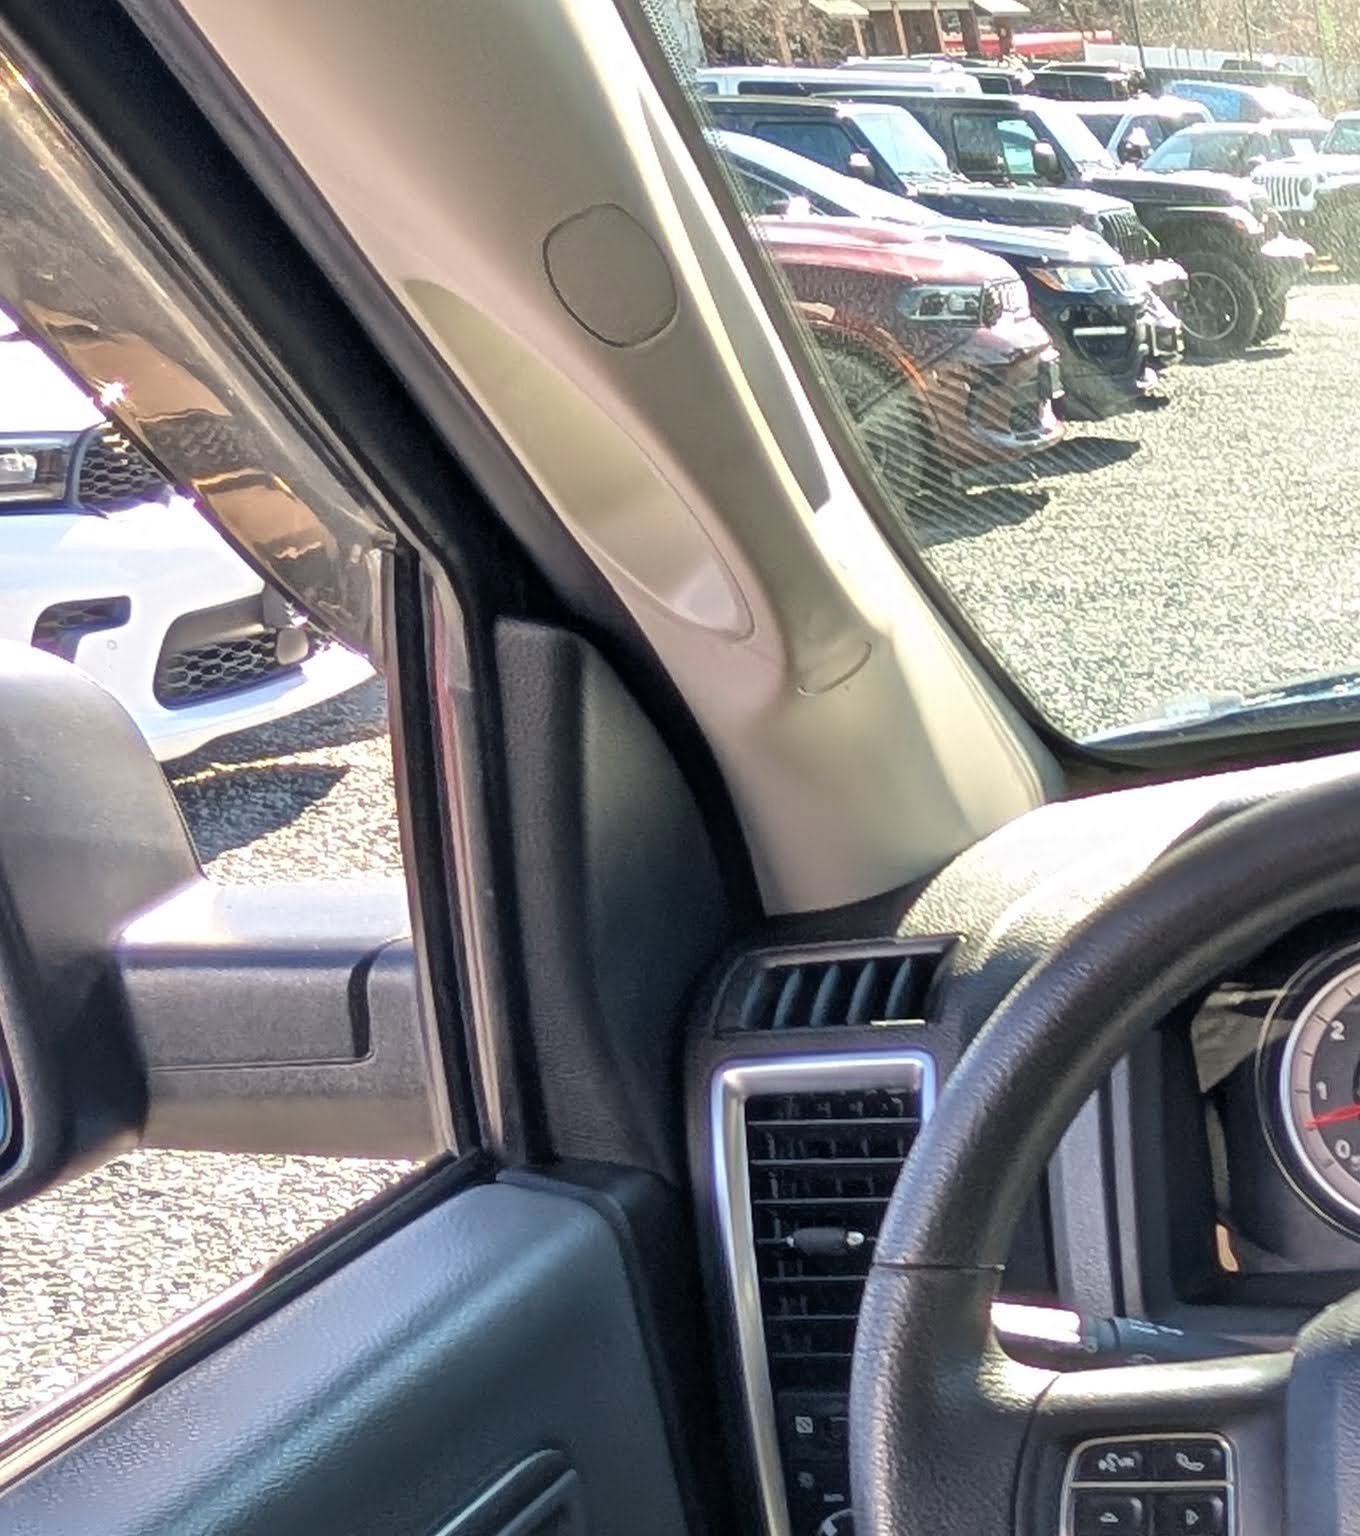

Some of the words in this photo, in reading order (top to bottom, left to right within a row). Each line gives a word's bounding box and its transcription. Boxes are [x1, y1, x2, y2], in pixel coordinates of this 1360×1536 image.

[1330, 1020, 1345, 1041] 2
[1316, 1081, 1328, 1101] 1
[1334, 1138, 1351, 1160] 0
